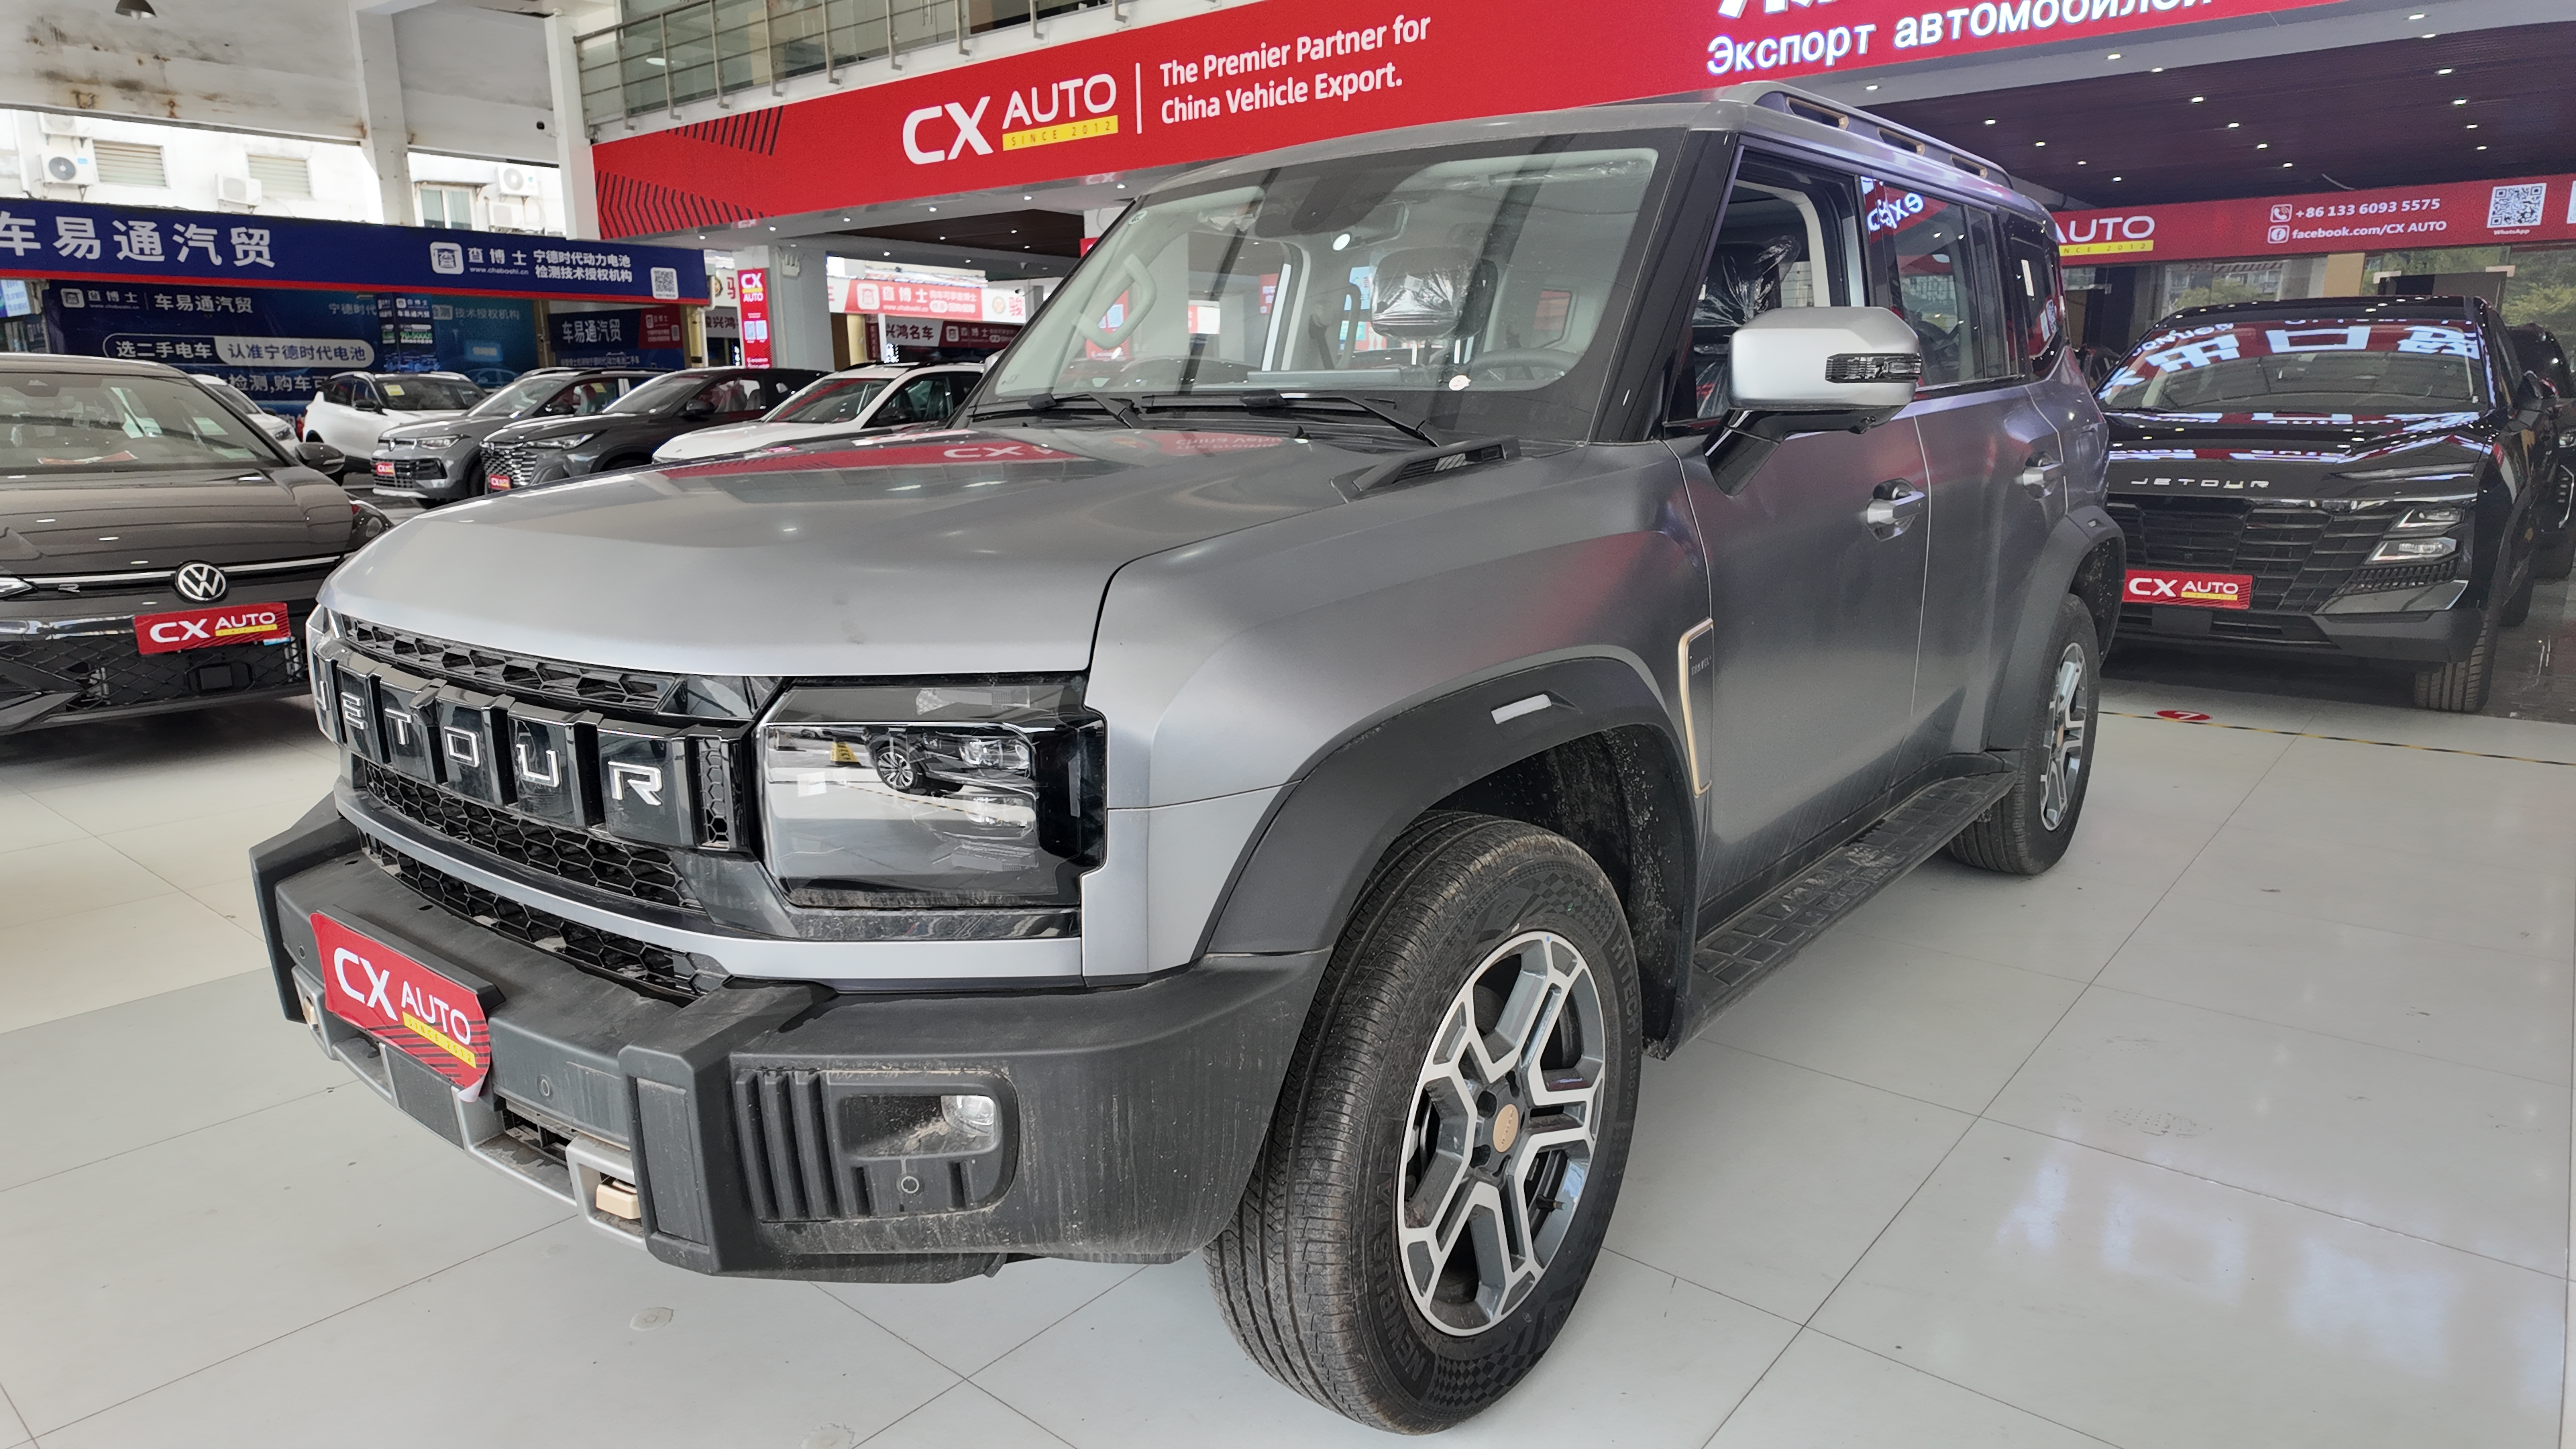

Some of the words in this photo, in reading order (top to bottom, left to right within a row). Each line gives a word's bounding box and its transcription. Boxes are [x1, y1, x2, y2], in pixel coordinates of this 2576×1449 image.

[1159, 60, 1199, 88] The
[1203, 42, 1291, 80] Premier
[1297, 28, 1388, 64] Partner
[1393, 15, 1432, 46] for
[1707, 23, 1877, 75] Экспорт
[1161, 93, 1220, 125] China
[1225, 76, 1309, 114] Vehicle
[1313, 62, 1403, 105] Export.
[901, 96, 994, 166] CX
[1002, 73, 1118, 129] AUTO
[1010, 127, 1061, 147] SINCE
[1071, 119, 1114, 138] 2012
[2295, 205, 2324, 218] +86
[2327, 204, 2355, 217] 133
[2359, 201, 2397, 215] 6093
[2401, 198, 2441, 212] 5575
[0, 211, 276, 268] 车易通汽贸
[2292, 223, 2406, 239] facebook.com/CX
[2407, 221, 2447, 233] AUTO
[468, 247, 527, 266] 查博士
[2106, 243, 2146, 252] 2012
[533, 250, 631, 268] 宁德时代动力电池
[535, 265, 633, 282] 检测技术授权机构
[741, 272, 763, 289] CX
[154, 292, 254, 314] 车易通汽贸
[743, 292, 763, 302] AUTO
[561, 319, 622, 343] 车易通汽贸
[115, 341, 213, 360] 选二手电车
[228, 344, 366, 363] 认准宁德时代电池
[2131, 478, 2269, 488] JETOUR
[2129, 578, 2178, 597] CX
[2182, 580, 2239, 594] AUTO
[150, 619, 211, 643] CX
[215, 612, 276, 630] AUTO
[315, 680, 663, 806] JETOUR
[334, 947, 398, 1022] CX
[401, 981, 471, 1045] AUTO
[409, 1018, 439, 1042] SINCE
[446, 1040, 472, 1063] 2012
